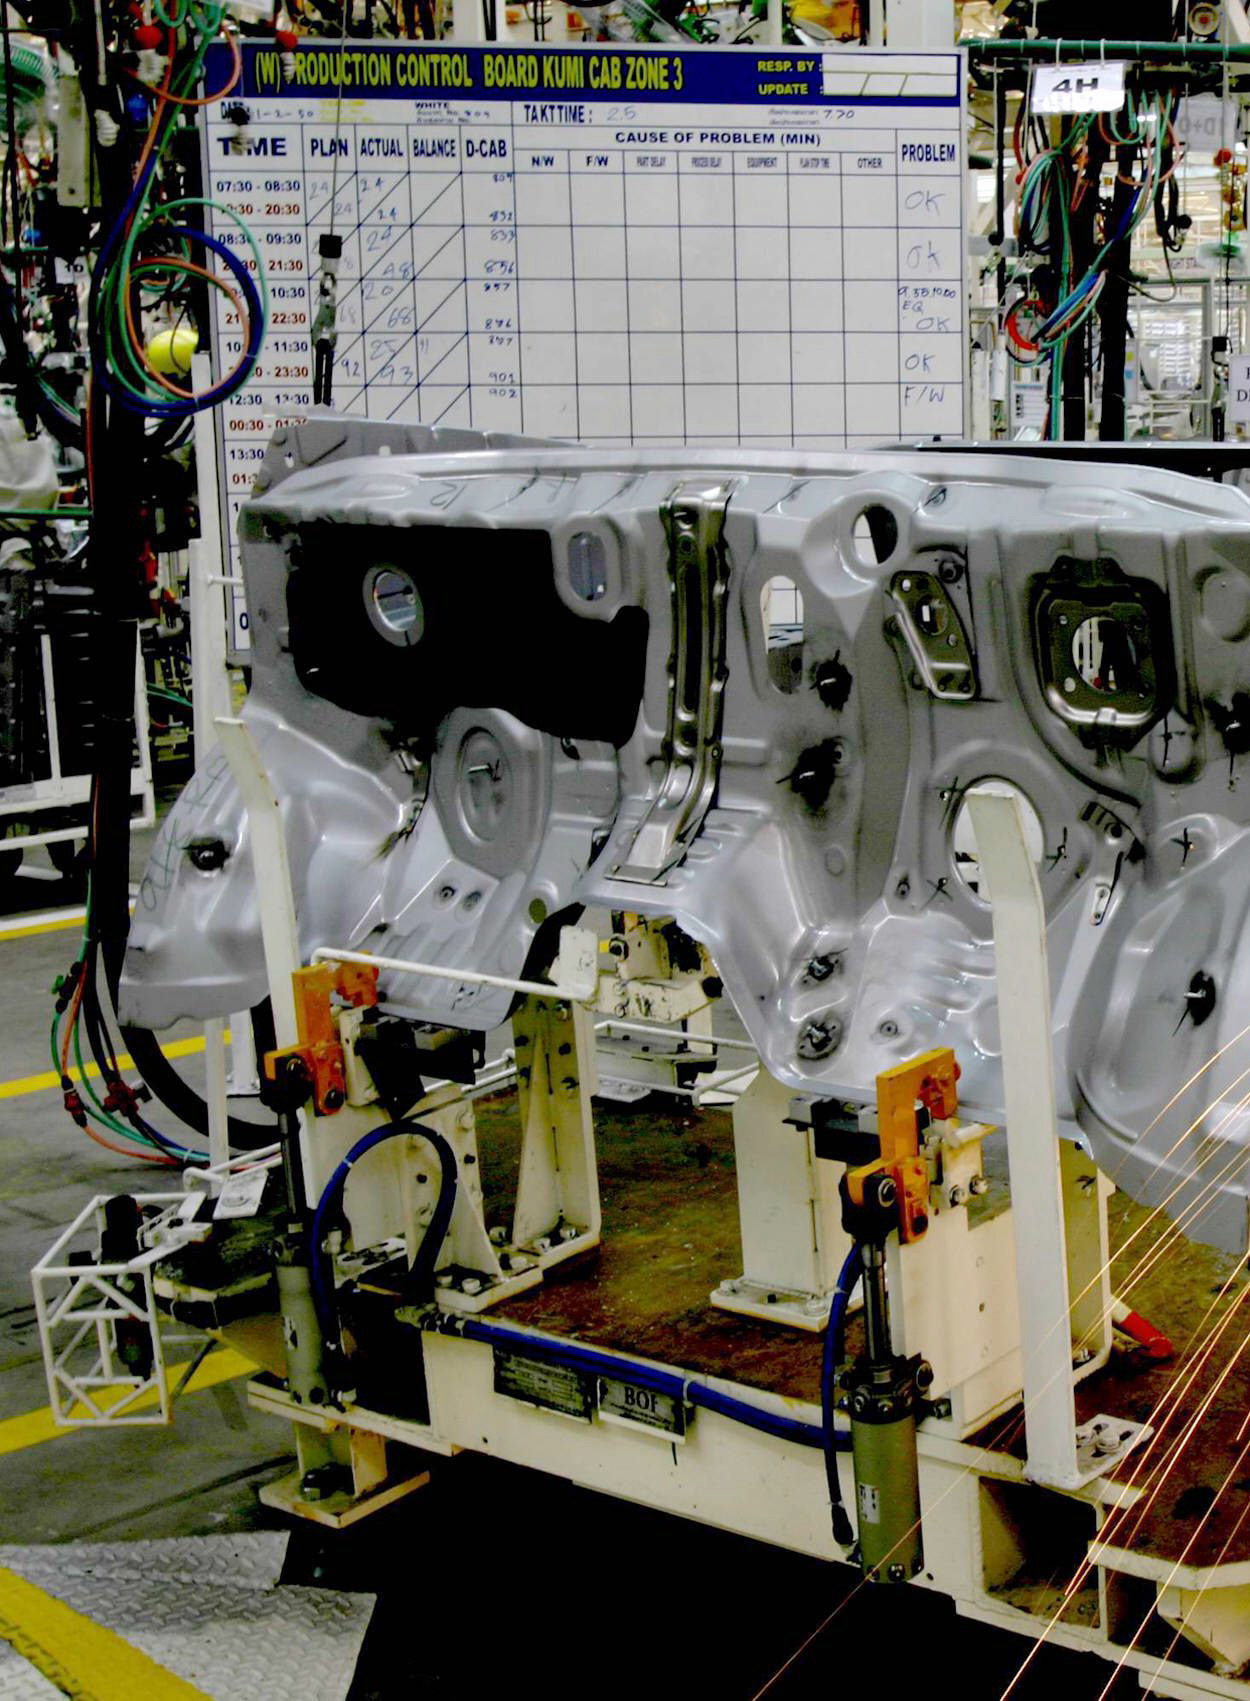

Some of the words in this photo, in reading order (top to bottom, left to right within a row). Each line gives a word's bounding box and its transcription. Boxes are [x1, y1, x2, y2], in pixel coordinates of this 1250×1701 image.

[291, 53, 391, 86] RODUCTION
[398, 54, 473, 87] CONTROL
[483, 54, 539, 88] BOARD
[543, 56, 585, 88] KUMI
[589, 57, 622, 89] CAB
[625, 57, 669, 90] ZONE
[673, 57, 683, 90] 3
[757, 61, 794, 72] RESP.
[796, 61, 816, 72] BY
[758, 83, 808, 95] UPDATE
[1052, 77, 1099, 93] 4H
[615, 132, 669, 144] CAUSE
[674, 132, 694, 144] OF
[700, 132, 775, 145] PROBLEM
[780, 133, 821, 148] (MIN)
[216, 138, 287, 156] TME
[311, 138, 348, 157] PLAN
[360, 138, 404, 157] ACTUAL
[413, 138, 456, 158] BALANCE
[466, 139, 507, 158] D-CAB
[902, 143, 956, 163] PROBLEM
[531, 156, 554, 167] N/W
[586, 156, 609, 167] F/W
[857, 157, 883, 169] OTHER
[216, 181, 253, 192] 07:30
[264, 181, 300, 192] 08:30
[265, 204, 300, 215] 20:30
[218, 233, 247, 245] 08:3
[266, 233, 302, 244] 09:30
[268, 260, 303, 271] 21:30
[271, 287, 305, 299] 10:30
[272, 313, 306, 324] 22:30
[274, 342, 308, 353] 11:30
[275, 366, 309, 378] 23:30
[229, 394, 263, 406] 12:30
[229, 420, 264, 431] 00:30
[229, 449, 264, 460] 13:30
